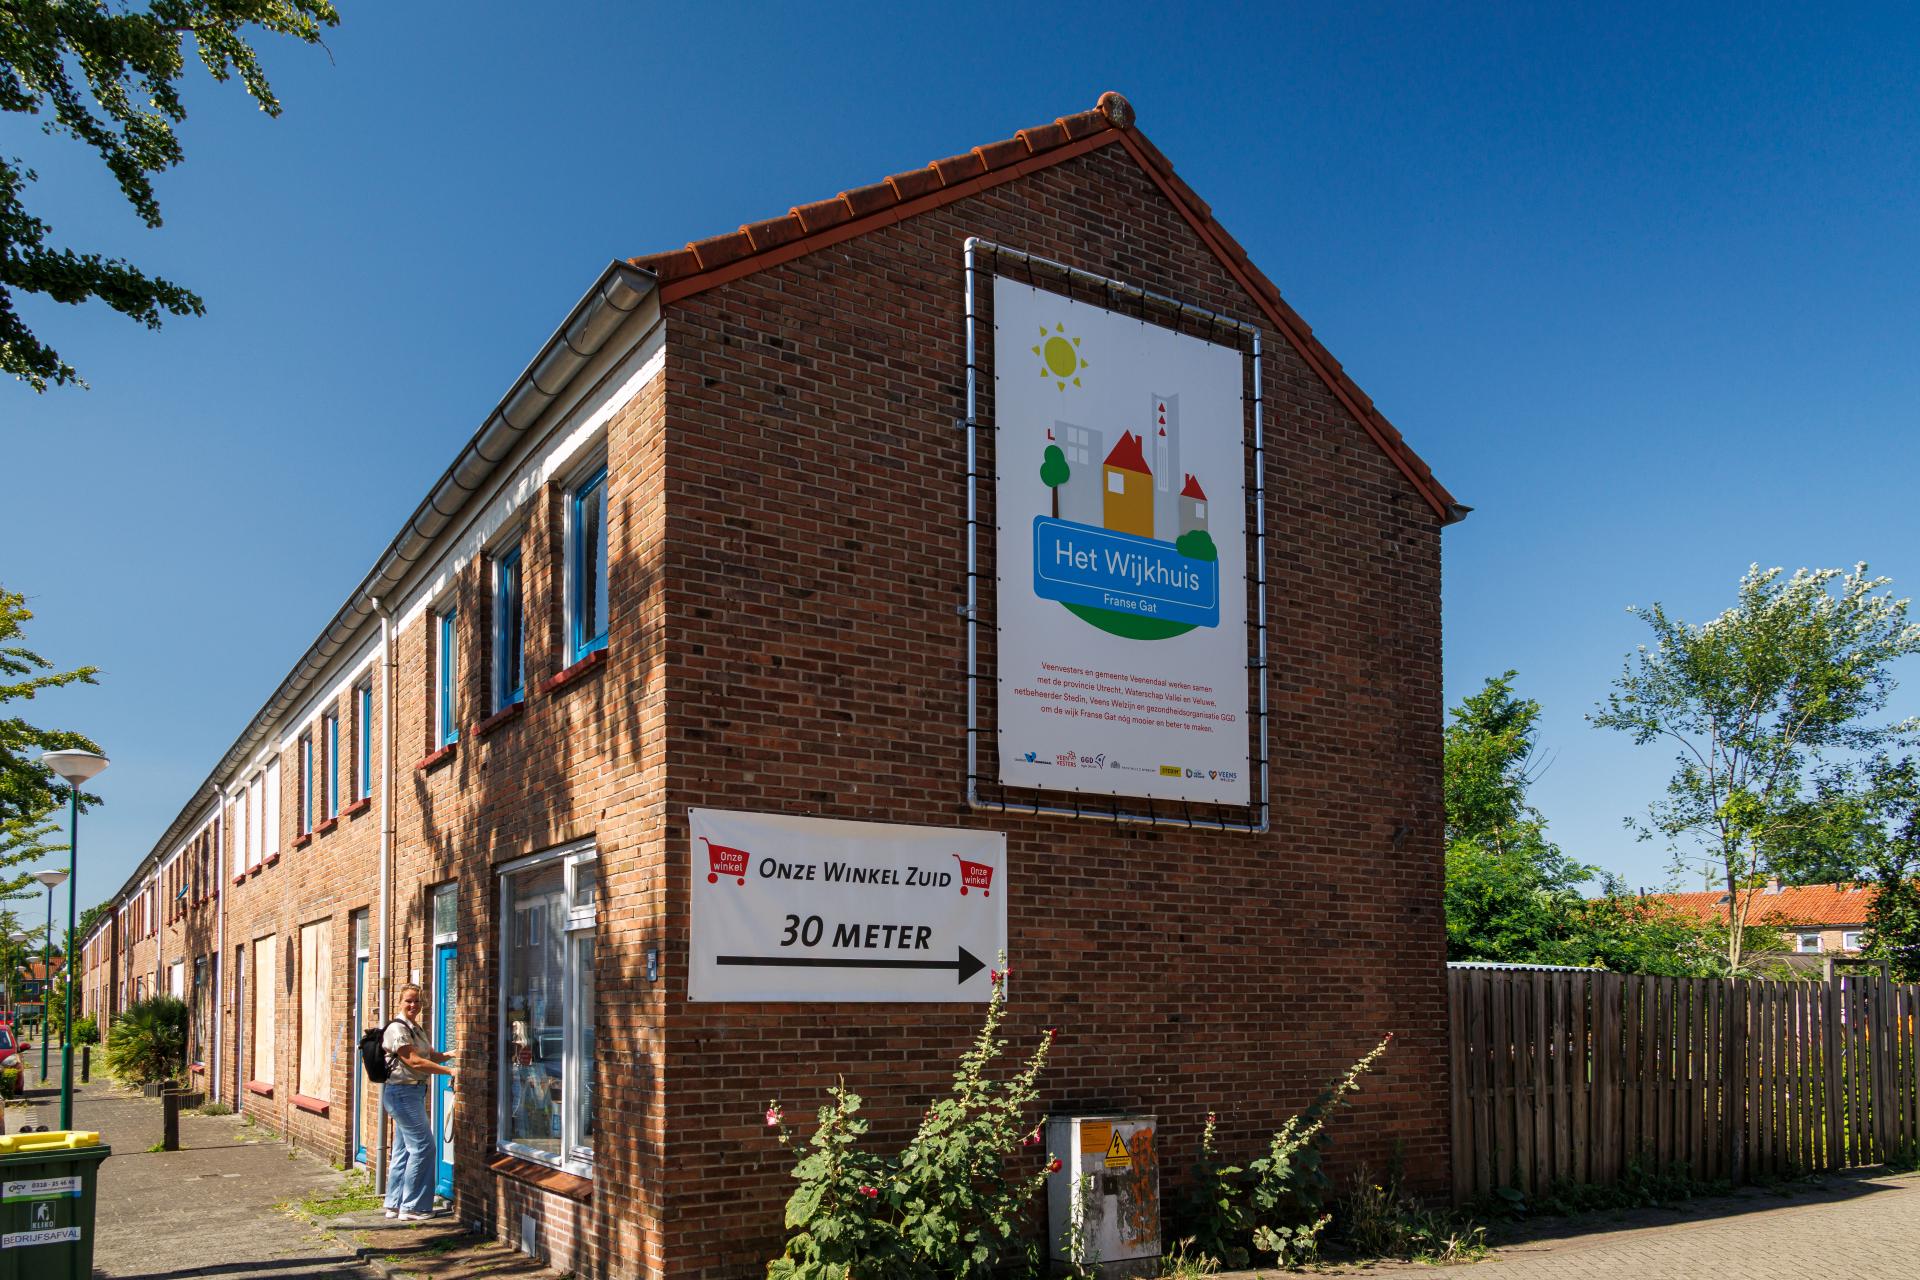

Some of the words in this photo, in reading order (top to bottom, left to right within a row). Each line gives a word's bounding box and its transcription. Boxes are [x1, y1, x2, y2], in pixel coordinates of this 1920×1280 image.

[1056, 539, 1098, 572] Het
[1105, 548, 1200, 591] Wijkhuis
[1104, 593, 1137, 610] Franse
[1139, 600, 1157, 614] Gat
[1041, 662, 1084, 675] Veenvesters
[1095, 671, 1128, 681] gemeente
[1130, 675, 1167, 686] Veenendaal
[1168, 680, 1192, 690] werken
[1193, 685, 1213, 693] samen
[1052, 678, 1062, 686] de
[1063, 680, 1095, 691] provincie
[1096, 683, 1123, 694] Utrecht,
[1124, 688, 1164, 700] Waterschap
[1165, 693, 1182, 702] Vallei
[1193, 697, 1216, 708] Veluwe,
[1014, 688, 1062, 700] netbeheerder
[1063, 693, 1088, 705] Stedin,
[1090, 697, 1110, 706] Veens
[1111, 699, 1136, 710] Welzijn
[1146, 705, 1219, 720] gezondheidsorganisatie
[1220, 713, 1236, 722] GGD
[1054, 706, 1063, 714] de
[1064, 708, 1079, 717] wijk
[1080, 709, 1103, 719] Franse
[1104, 712, 1116, 720] Gat
[1132, 717, 1156, 725] mooier
[1165, 720, 1183, 729] beter
[1192, 724, 1214, 733] maken.
[1080, 756, 1094, 764] GGD
[714, 861, 743, 872] winkel
[720, 851, 743, 862] Onze
[964, 875, 988, 885] winkel
[970, 866, 987, 876] Onze
[780, 914, 824, 947] 30
[832, 924, 932, 949] METER
[4, 1230, 79, 1245] BEDRIJFSAFVAL
